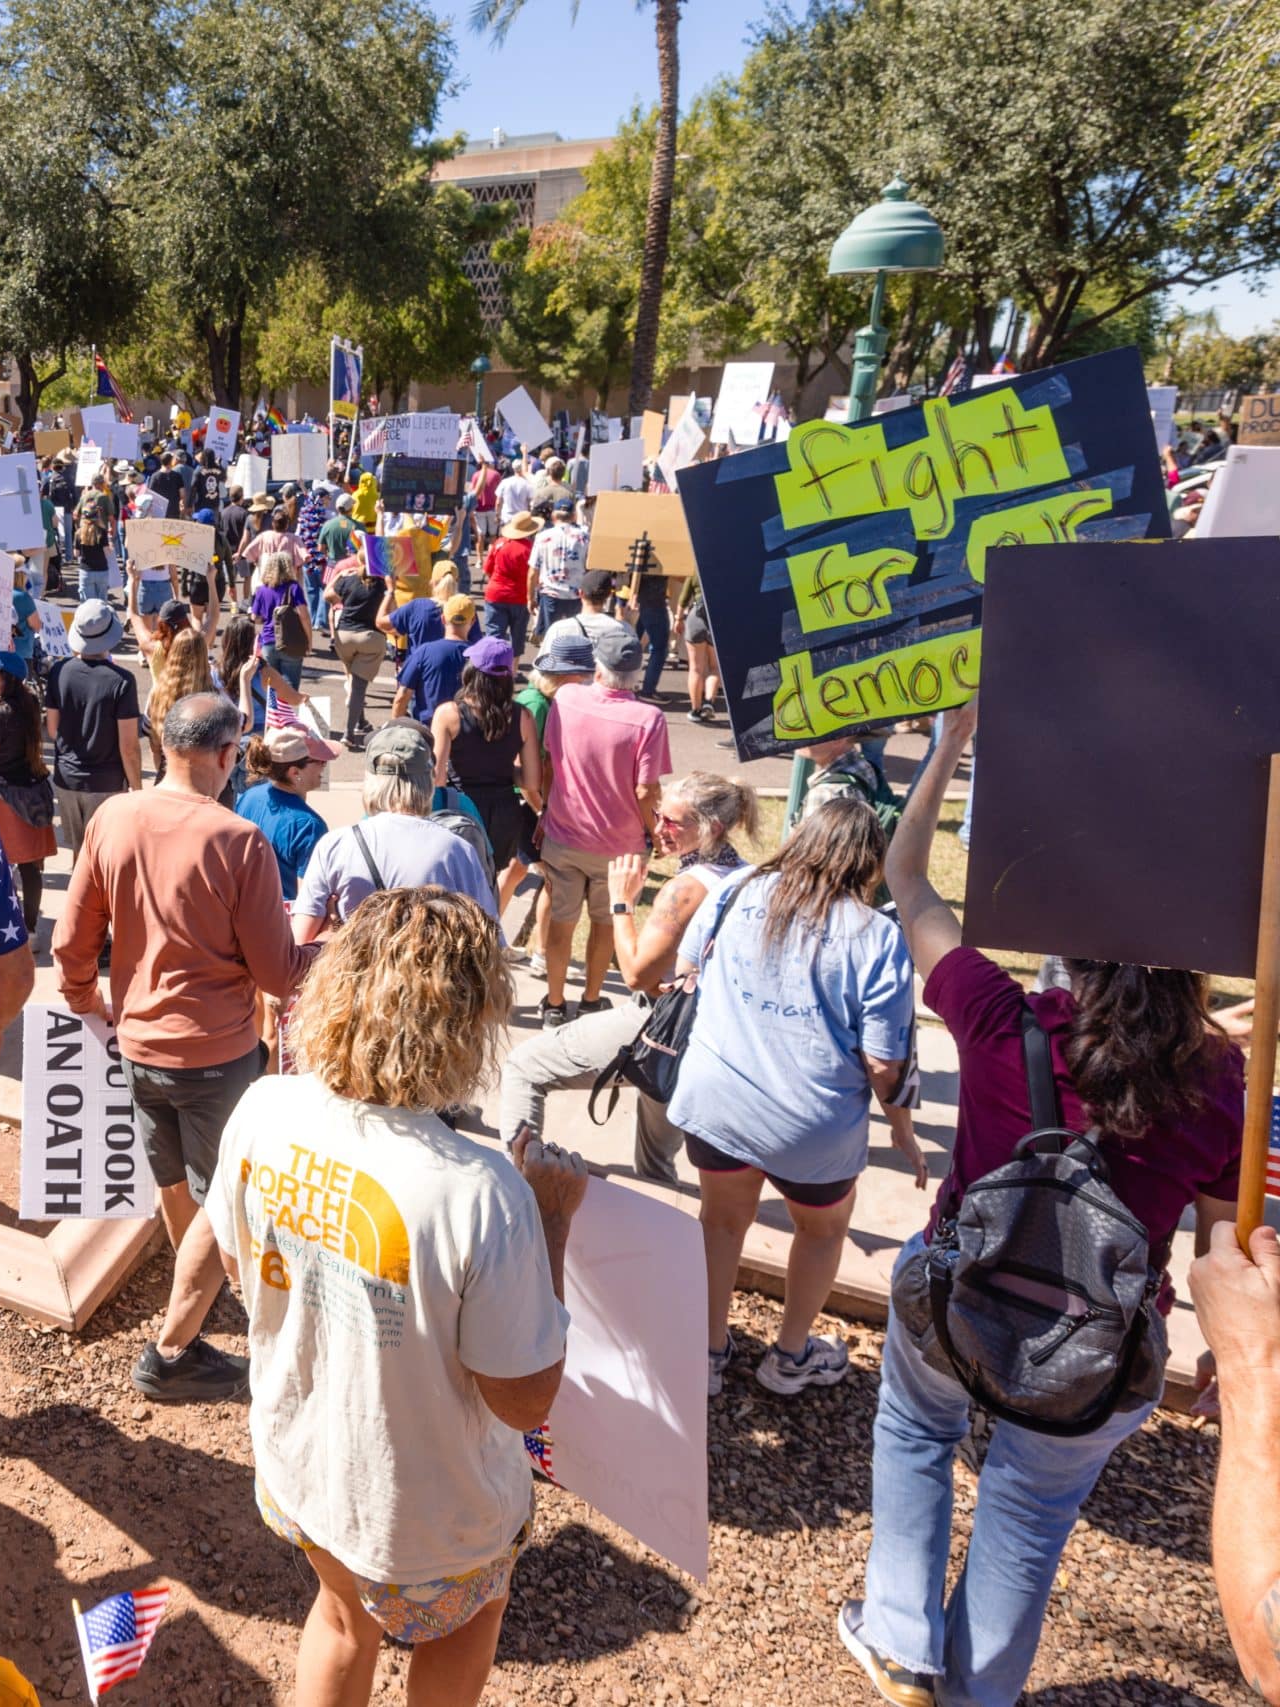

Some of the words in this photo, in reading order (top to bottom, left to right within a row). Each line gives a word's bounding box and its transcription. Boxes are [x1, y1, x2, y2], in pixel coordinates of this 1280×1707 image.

[412, 416, 459, 431] LIBERTY
[797, 401, 1043, 537] fight
[808, 548, 910, 619] for
[774, 646, 980, 735] democ
[46, 1010, 83, 1071] AN
[44, 1083, 84, 1215] OATH
[104, 1098, 136, 1213] TOOK
[289, 1143, 354, 1196] THE
[241, 1157, 345, 1226] NORTH
[261, 1194, 345, 1254] FACE
[317, 1249, 407, 1305] California
